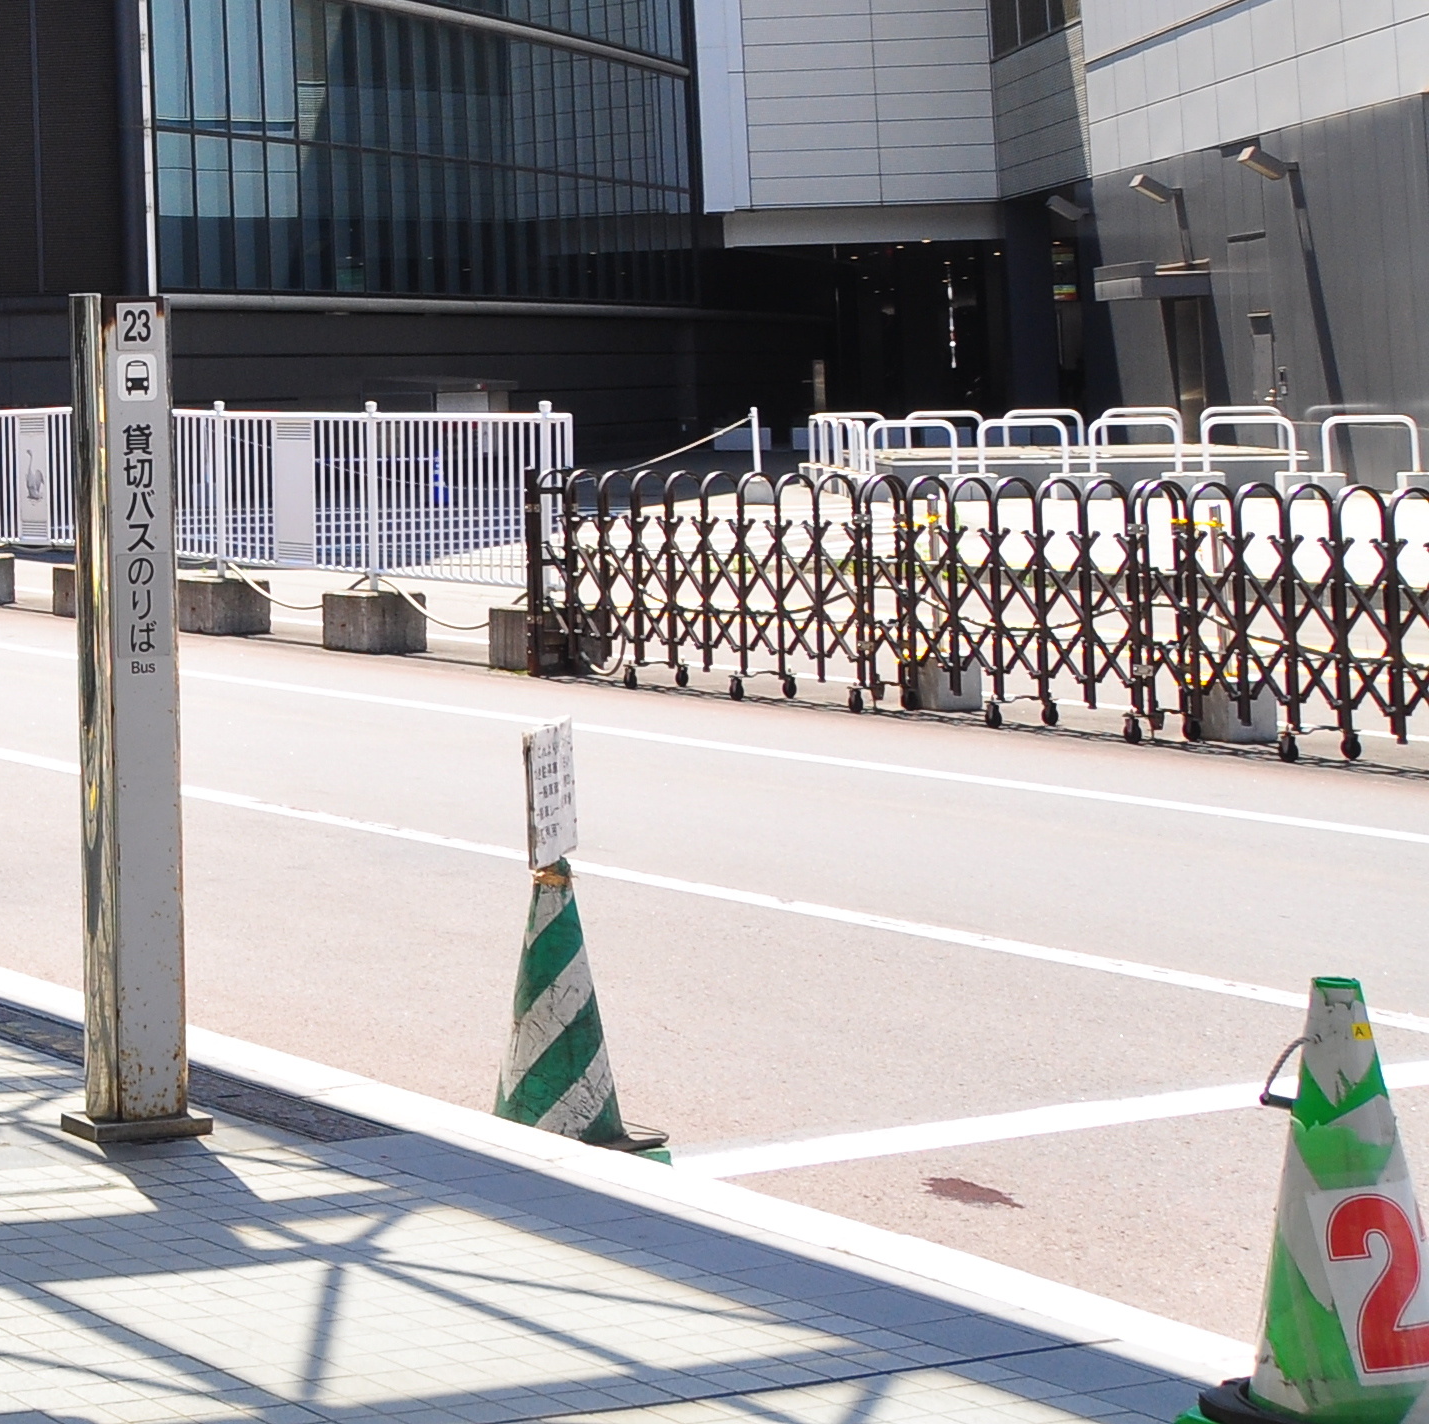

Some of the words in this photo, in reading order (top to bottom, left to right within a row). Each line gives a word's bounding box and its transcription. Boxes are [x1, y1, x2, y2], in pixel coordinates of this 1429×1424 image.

[122, 309, 152, 343] 23
[122, 423, 158, 654] 貸切バスのりば
[130, 661, 156, 675] Bus
[1326, 1192, 1429, 1374] 2
